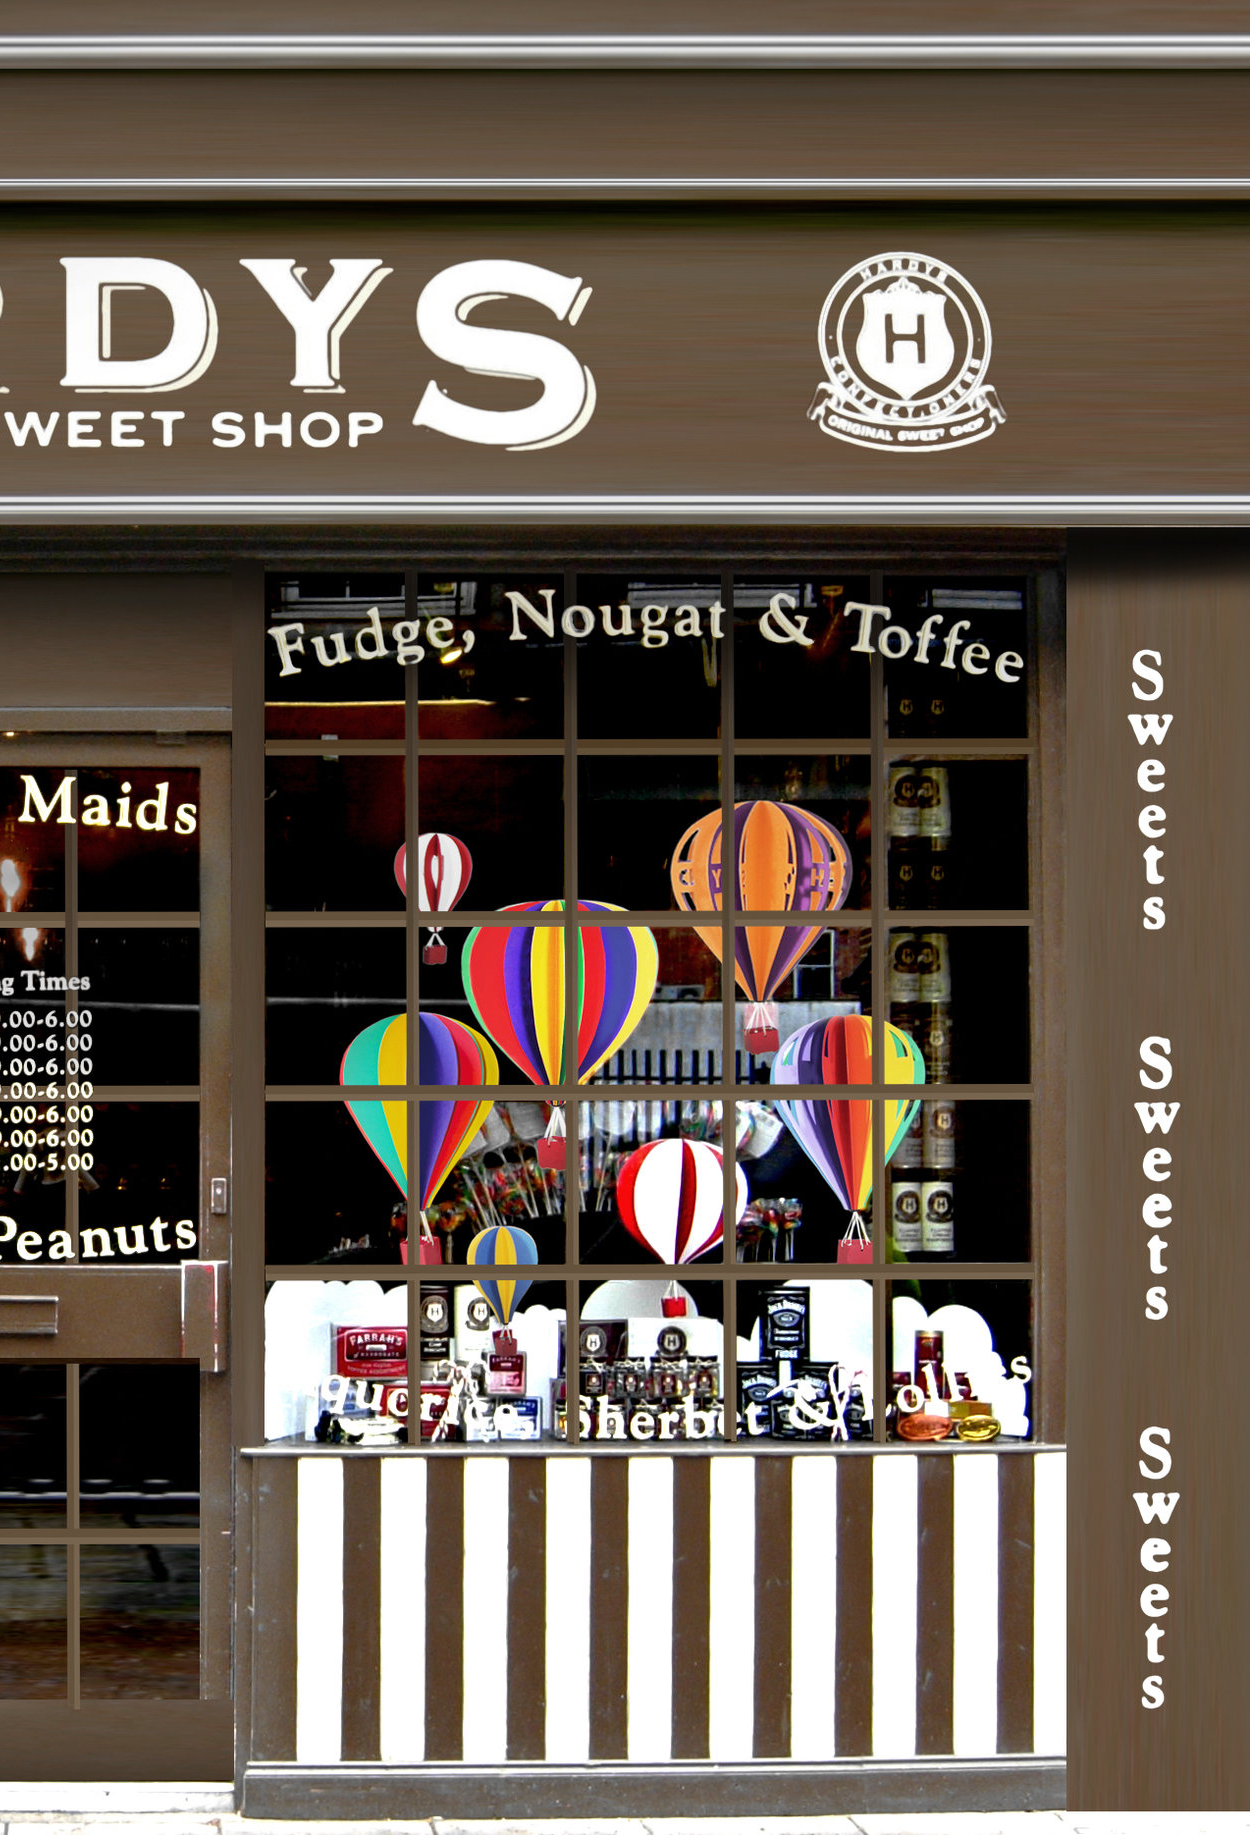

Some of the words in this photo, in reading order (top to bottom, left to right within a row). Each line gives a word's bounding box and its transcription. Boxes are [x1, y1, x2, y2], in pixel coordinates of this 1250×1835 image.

[884, 314, 926, 364] H
[210, 411, 384, 448] SHOP
[828, 414, 893, 441] ORIGINAL
[267, 606, 475, 677] Fudge,
[505, 589, 726, 648] Nougat
[759, 592, 815, 647] &
[844, 601, 1025, 683] Toffee
[18, 775, 198, 835] Maids
[1127, 649, 1174, 931] Sweets
[20, 970, 91, 992] Times
[1133, 1035, 1181, 1322] Sweets
[1132, 1425, 1181, 1711] Sweets
